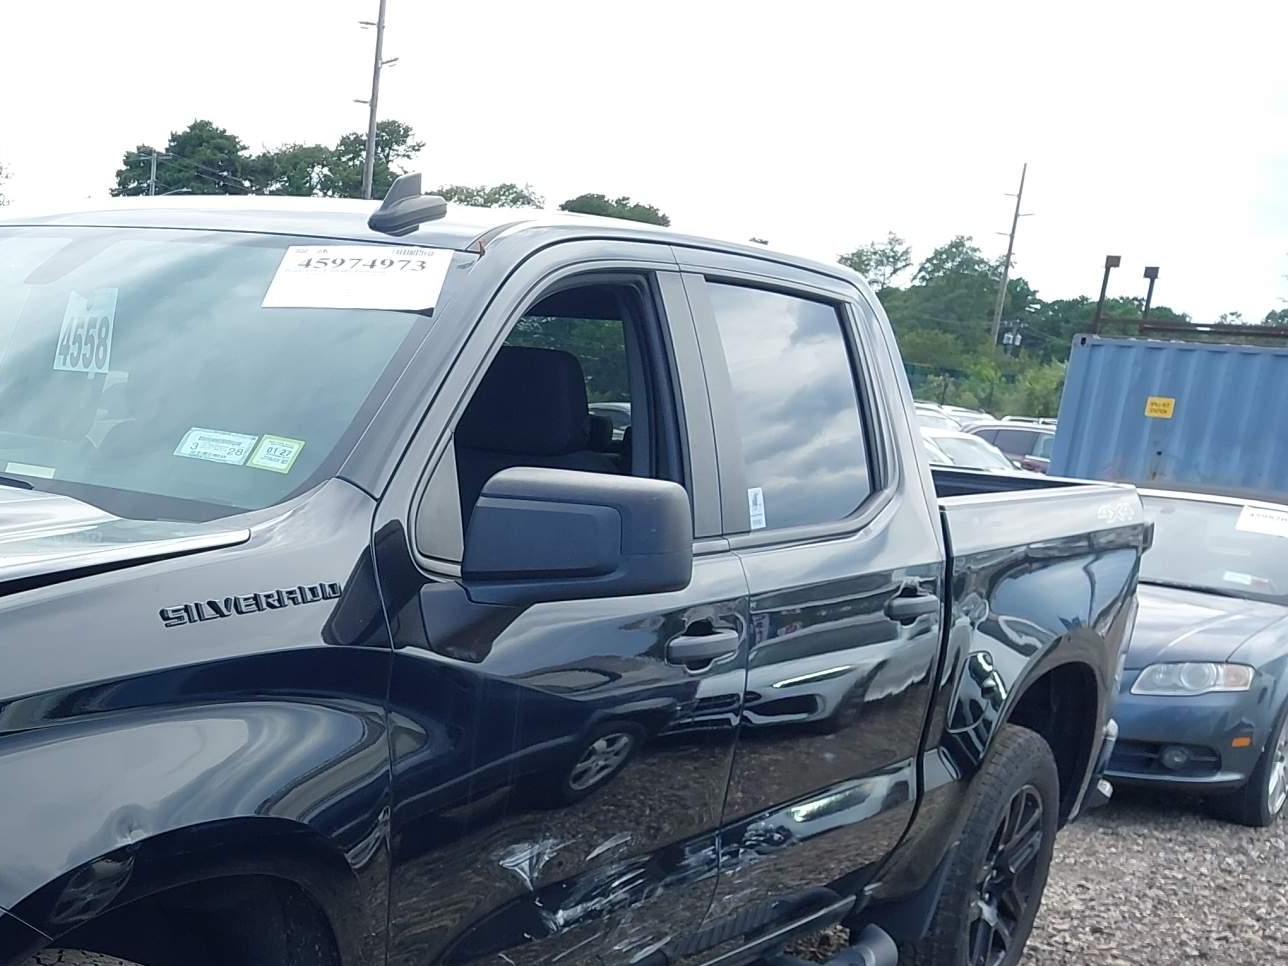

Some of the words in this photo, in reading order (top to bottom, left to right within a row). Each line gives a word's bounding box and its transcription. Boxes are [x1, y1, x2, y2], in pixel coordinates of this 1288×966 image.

[297, 257, 428, 272] 45974973
[58, 315, 110, 370] 4558
[226, 447, 245, 457] 28
[159, 582, 344, 628] SILVERADO
